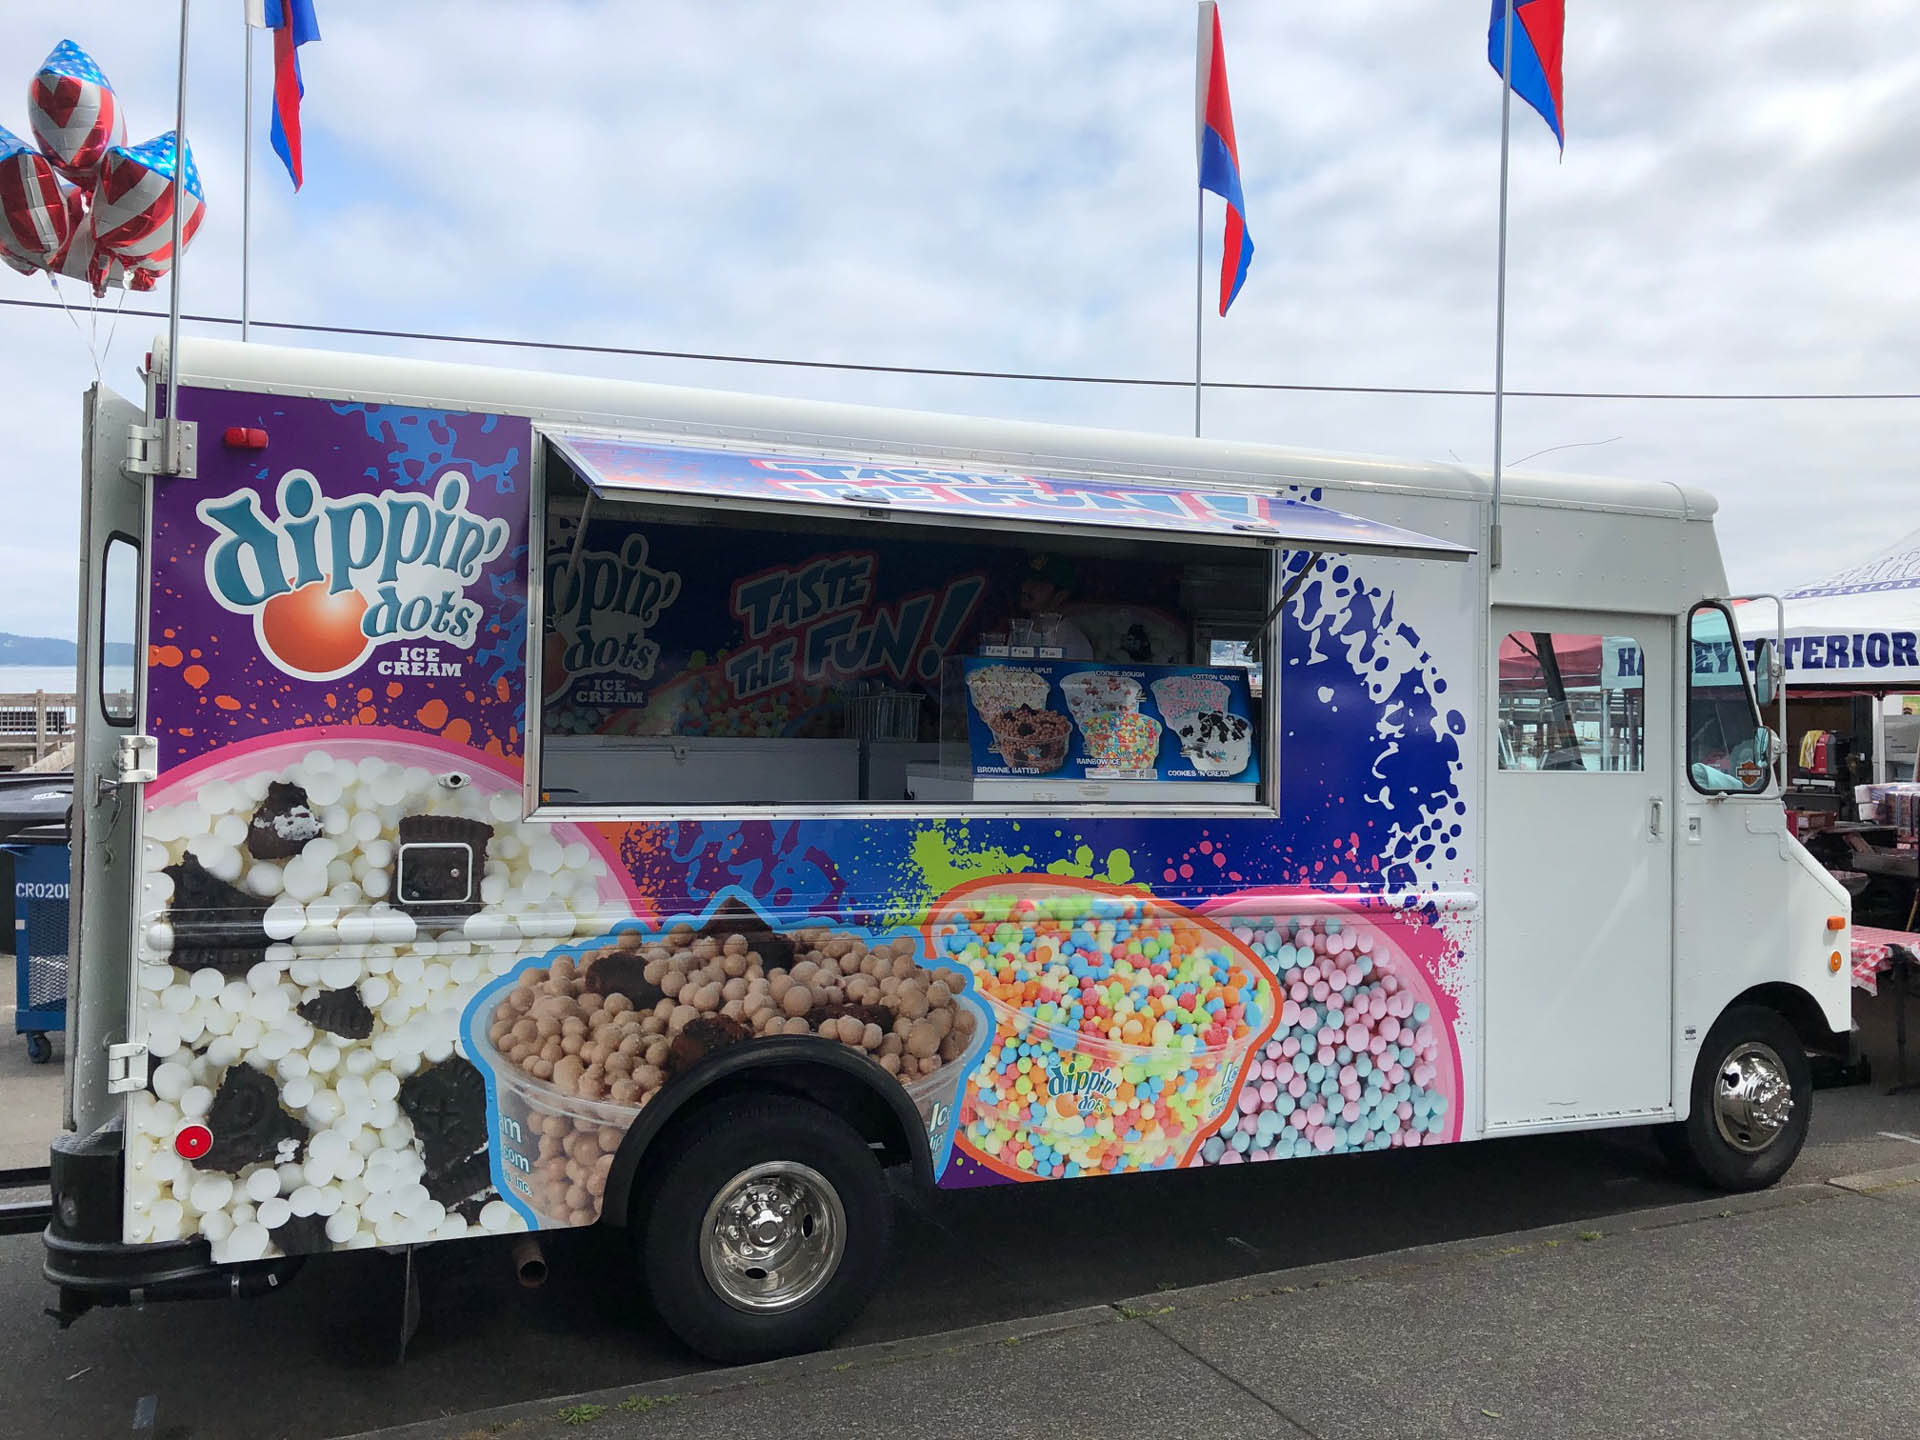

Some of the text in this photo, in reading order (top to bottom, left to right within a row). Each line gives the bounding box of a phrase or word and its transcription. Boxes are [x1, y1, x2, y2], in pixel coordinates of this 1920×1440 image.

[772, 462, 1036, 487] TASTE
[950, 485, 1262, 524] FUN!
[204, 476, 503, 607] dippin'
[546, 539, 677, 627] ppin'
[736, 554, 873, 639] TASTE
[361, 585, 474, 638] dots
[726, 575, 985, 698] THE FUN!
[400, 647, 440, 662] ICE
[563, 629, 650, 670] dots
[377, 661, 462, 677] CREAM
[1191, 673, 1217, 681] COTTON
[593, 678, 626, 691] ICE
[575, 690, 645, 704] CREAM
[977, 766, 1010, 774] BROWNIE
[1076, 757, 1109, 765] RAINBOW
[1168, 769, 1197, 777] COOKIES
